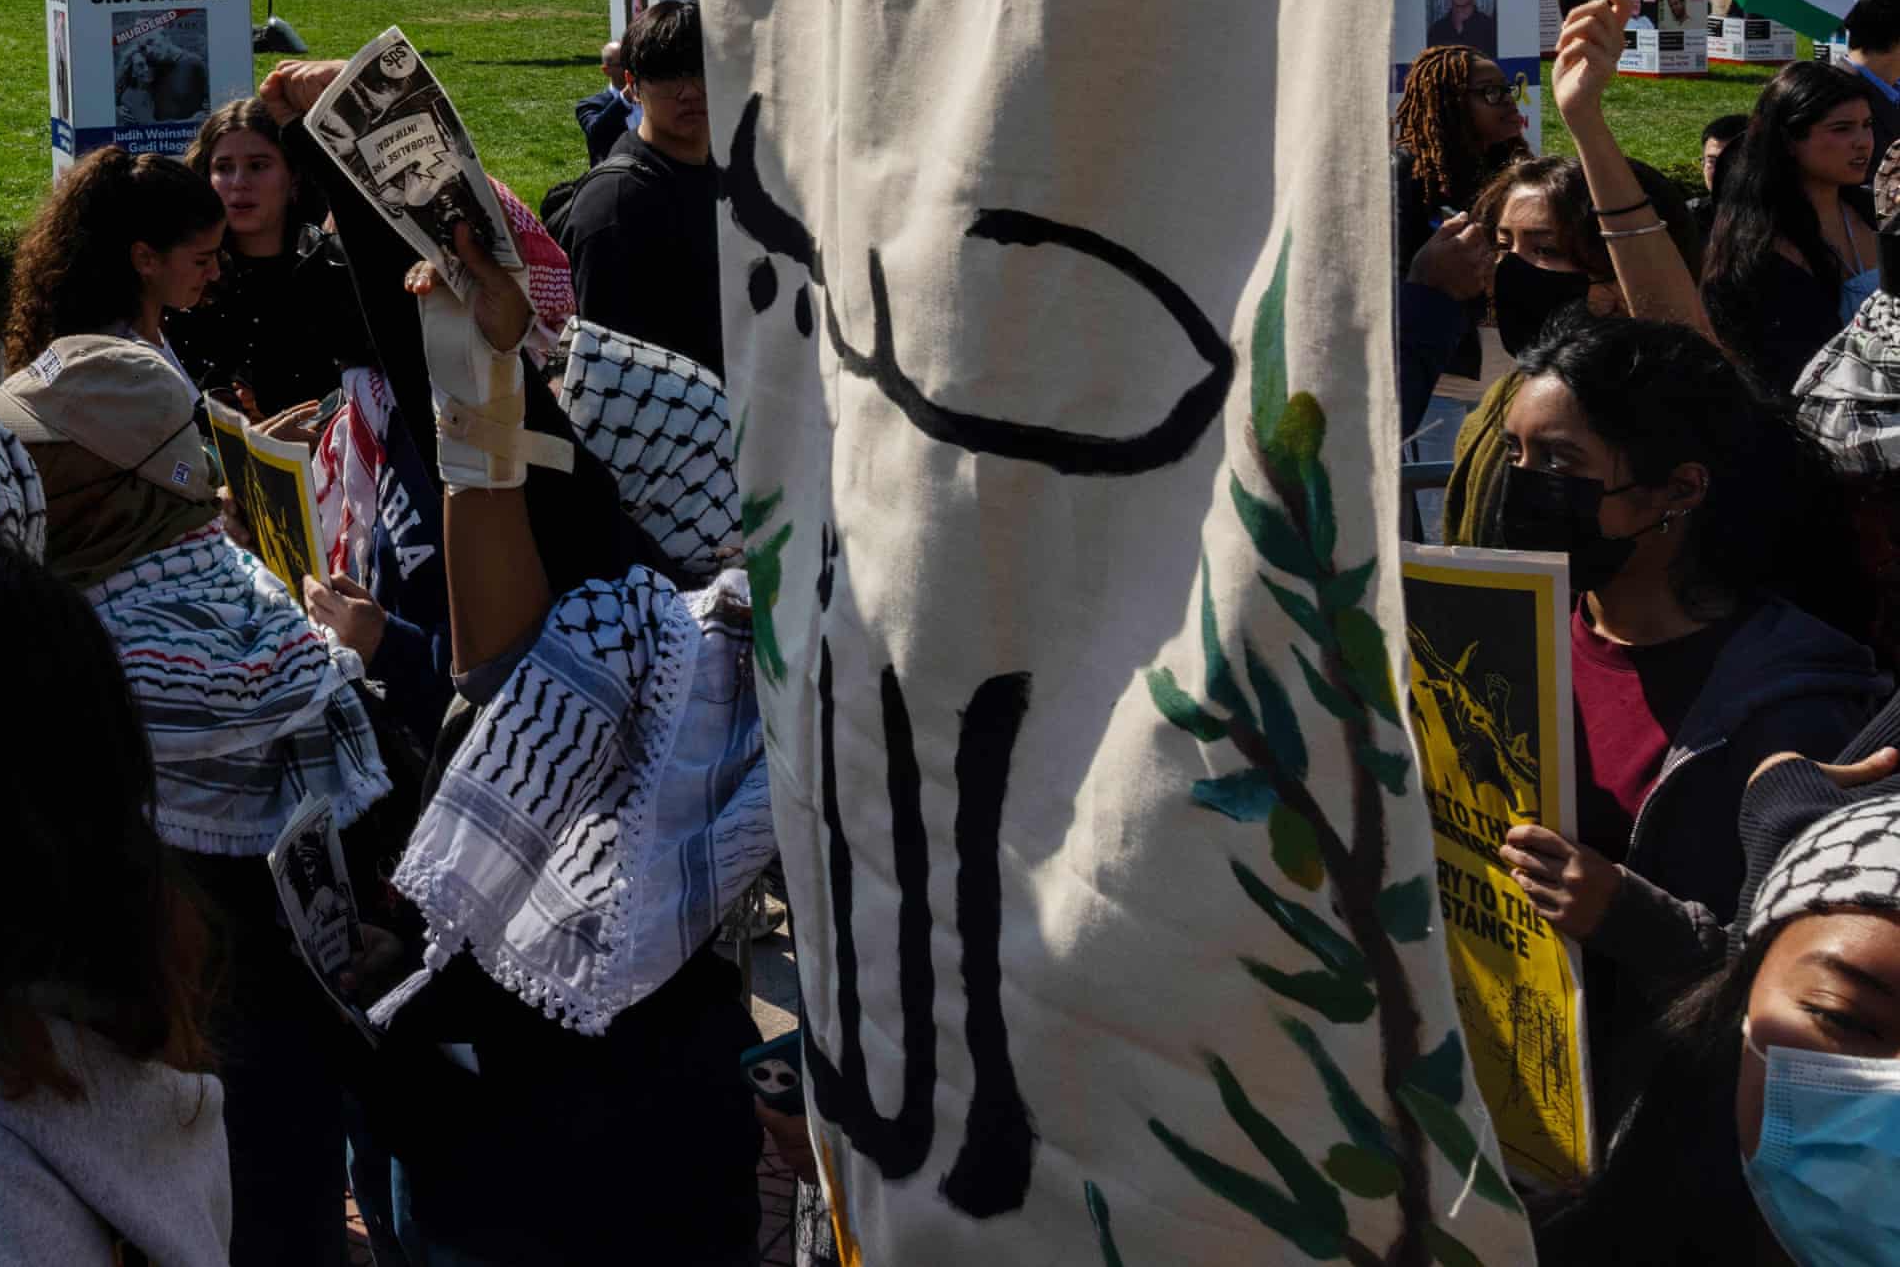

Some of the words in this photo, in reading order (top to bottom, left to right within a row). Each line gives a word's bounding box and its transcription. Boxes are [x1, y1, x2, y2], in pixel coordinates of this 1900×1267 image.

[115, 11, 177, 44] MURDERED
[382, 47, 407, 70] sds
[146, 126, 197, 139] Weinstei
[376, 123, 418, 154] INTIFADA!
[386, 134, 436, 165] GLOBALISE
[371, 160, 388, 175] THE
[1466, 873, 1497, 911] TO
[1500, 891, 1547, 939] THE
[1440, 891, 1531, 960] STANCE
